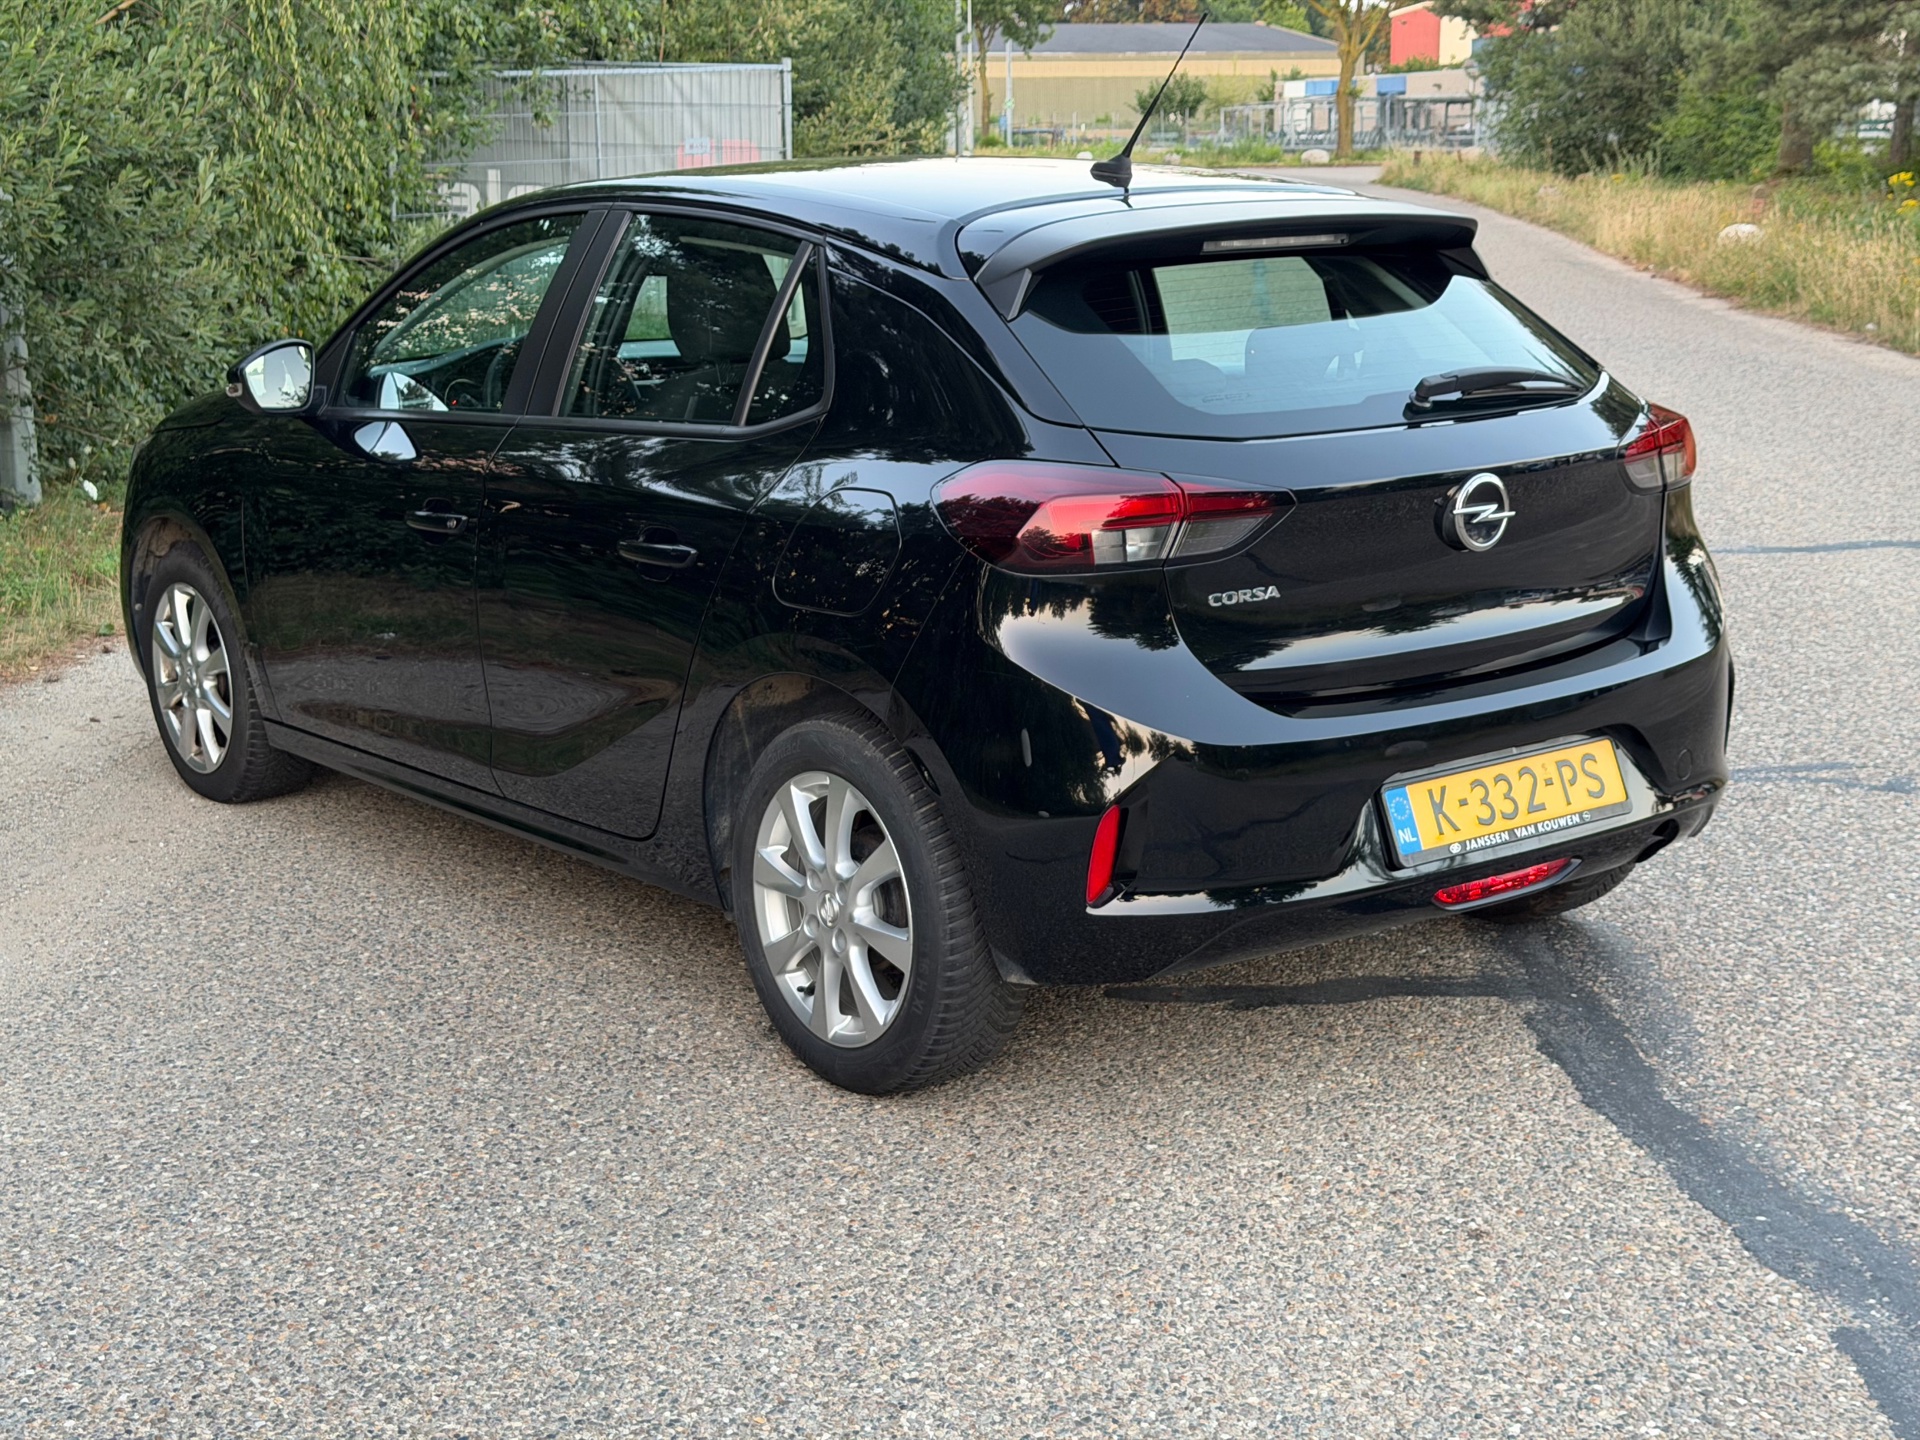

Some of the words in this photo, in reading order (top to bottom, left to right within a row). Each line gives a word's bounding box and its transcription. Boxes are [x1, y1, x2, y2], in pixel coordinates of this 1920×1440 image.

[1208, 585, 1281, 607] CORSA
[1427, 753, 1606, 836] K-332-PS
[1398, 828, 1417, 845] NL
[1466, 831, 1510, 851] JANSSEN
[1514, 824, 1536, 838] VAN
[1538, 813, 1580, 832] KOUWEN
